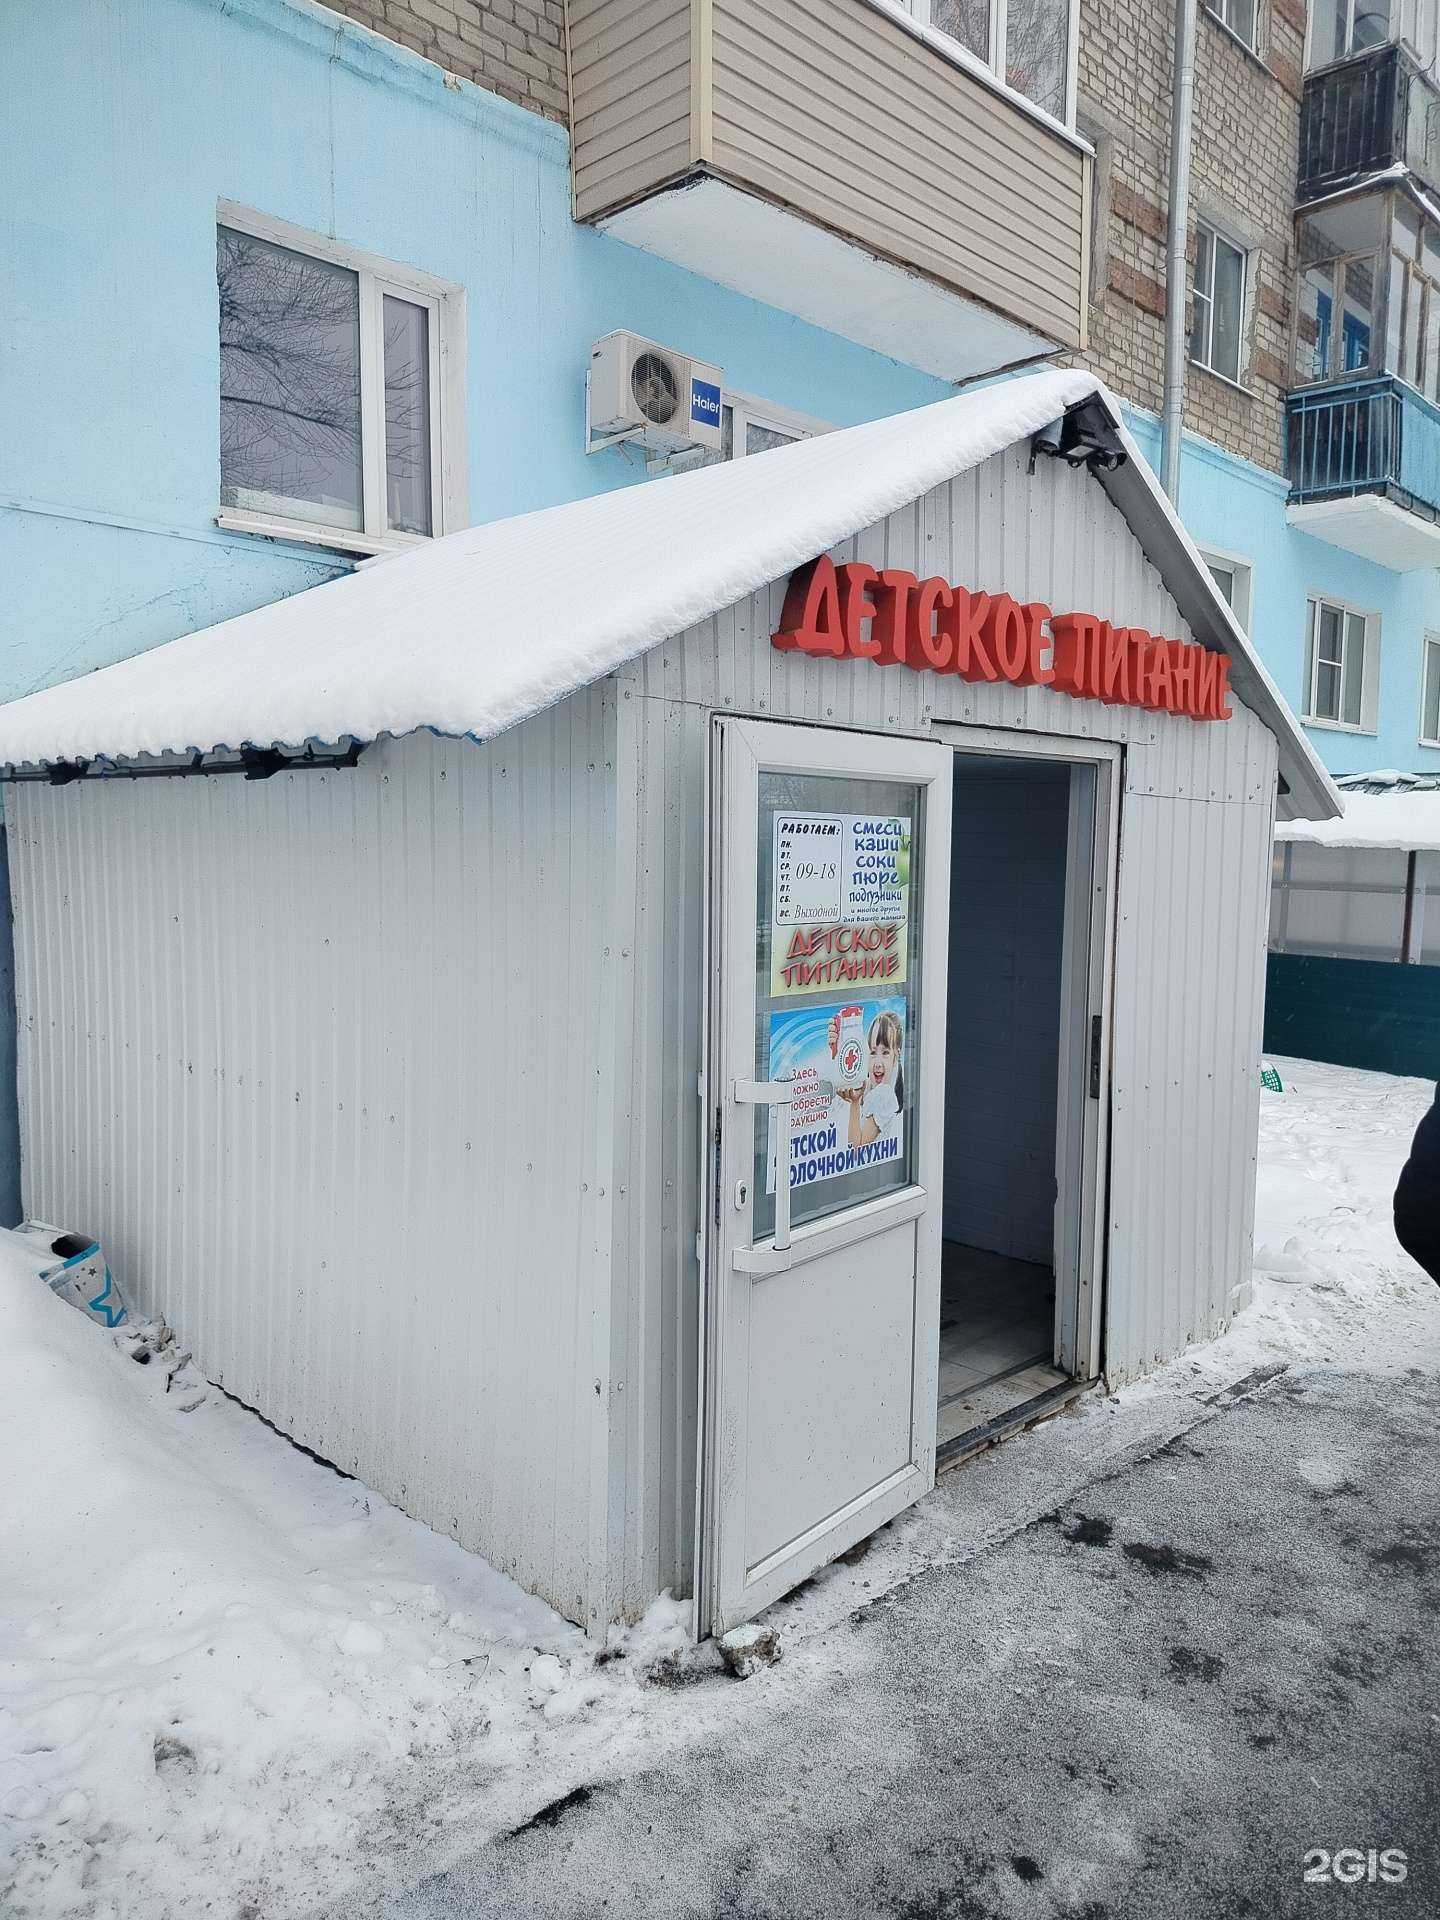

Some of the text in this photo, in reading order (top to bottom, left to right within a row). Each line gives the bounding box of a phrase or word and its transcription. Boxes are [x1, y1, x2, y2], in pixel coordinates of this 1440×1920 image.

[692, 393, 720, 414] Haier
[774, 553, 1232, 721] ДЕТСКОЕ ПИТАНИЕ
[781, 823, 840, 836] РАБОТАЕМ:
[852, 821, 902, 836] смеси
[854, 837, 899, 852] каши
[796, 862, 837, 880] 09-18
[855, 855, 896, 869] соки
[852, 870, 900, 892] пюре
[849, 887, 902, 906] подгузники
[794, 904, 838, 919] Выходной
[786, 923, 898, 959] ДЕТСКОЕ
[780, 951, 900, 988] ПИТАНИЕ
[789, 1137, 898, 1187] ОЛОЧНОЙ КУХНИ
